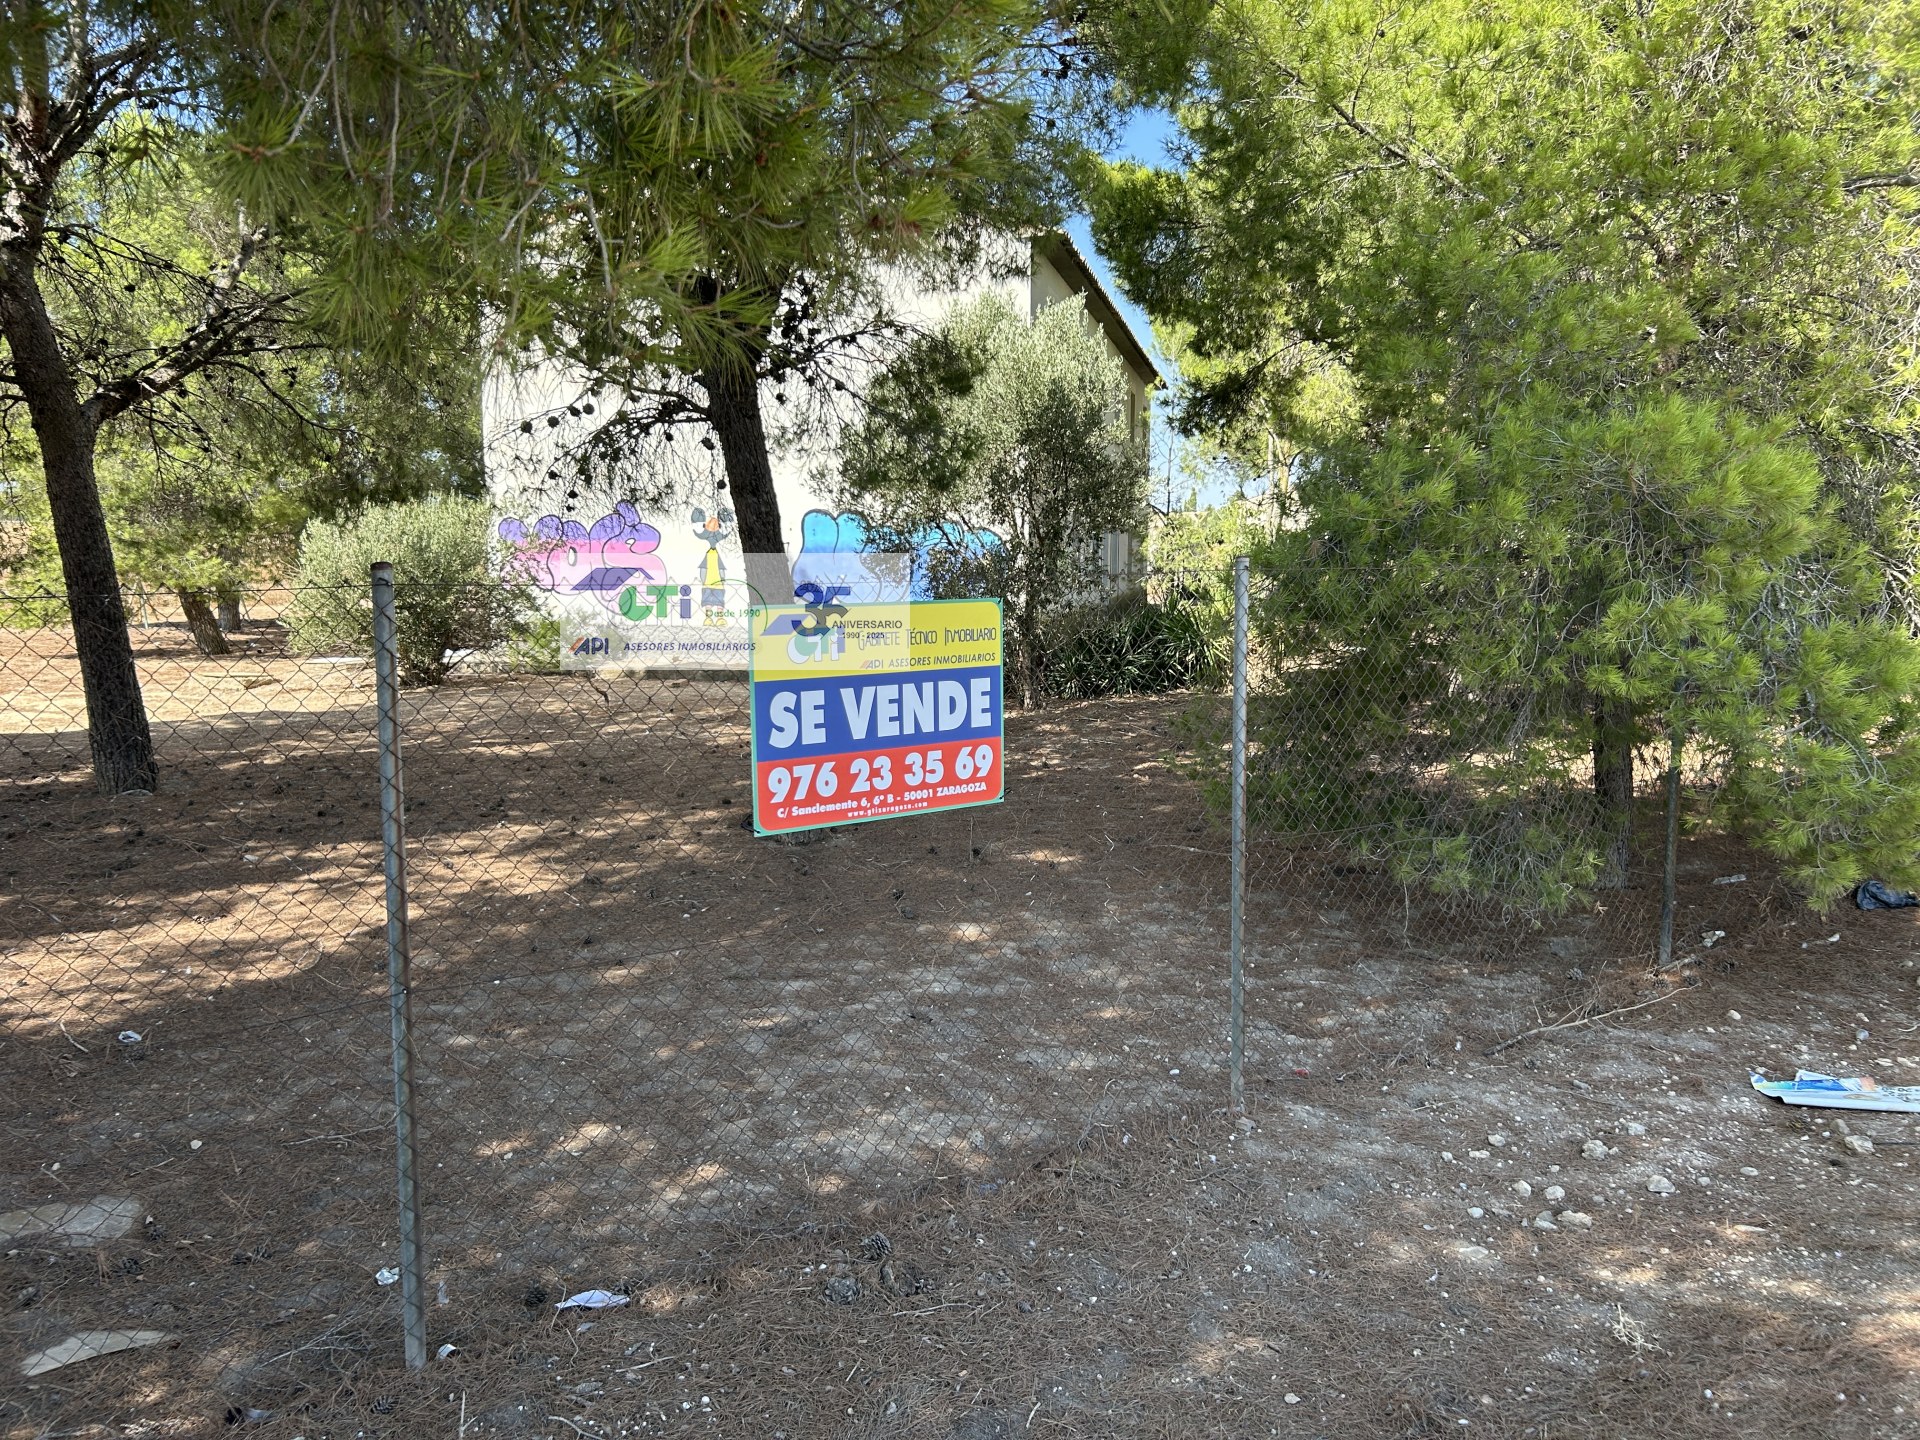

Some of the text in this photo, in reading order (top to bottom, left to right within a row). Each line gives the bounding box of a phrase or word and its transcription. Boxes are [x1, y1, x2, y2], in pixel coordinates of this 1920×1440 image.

[944, 627, 997, 644] INMOBILIARIO
[888, 656, 931, 668] ASESORES
[933, 652, 996, 665] INMOBILIARIOS
[768, 677, 992, 749] SE VENDE
[768, 744, 994, 803] 976 23 35 69
[777, 806, 789, 819] C/
[792, 800, 858, 816] Sanclemente
[860, 797, 871, 808] 6,
[887, 793, 894, 803] B
[904, 786, 934, 801] 50001
[936, 782, 987, 797] ZARAGOZA
[848, 802, 928, 818] www.gtizaragoza.com
